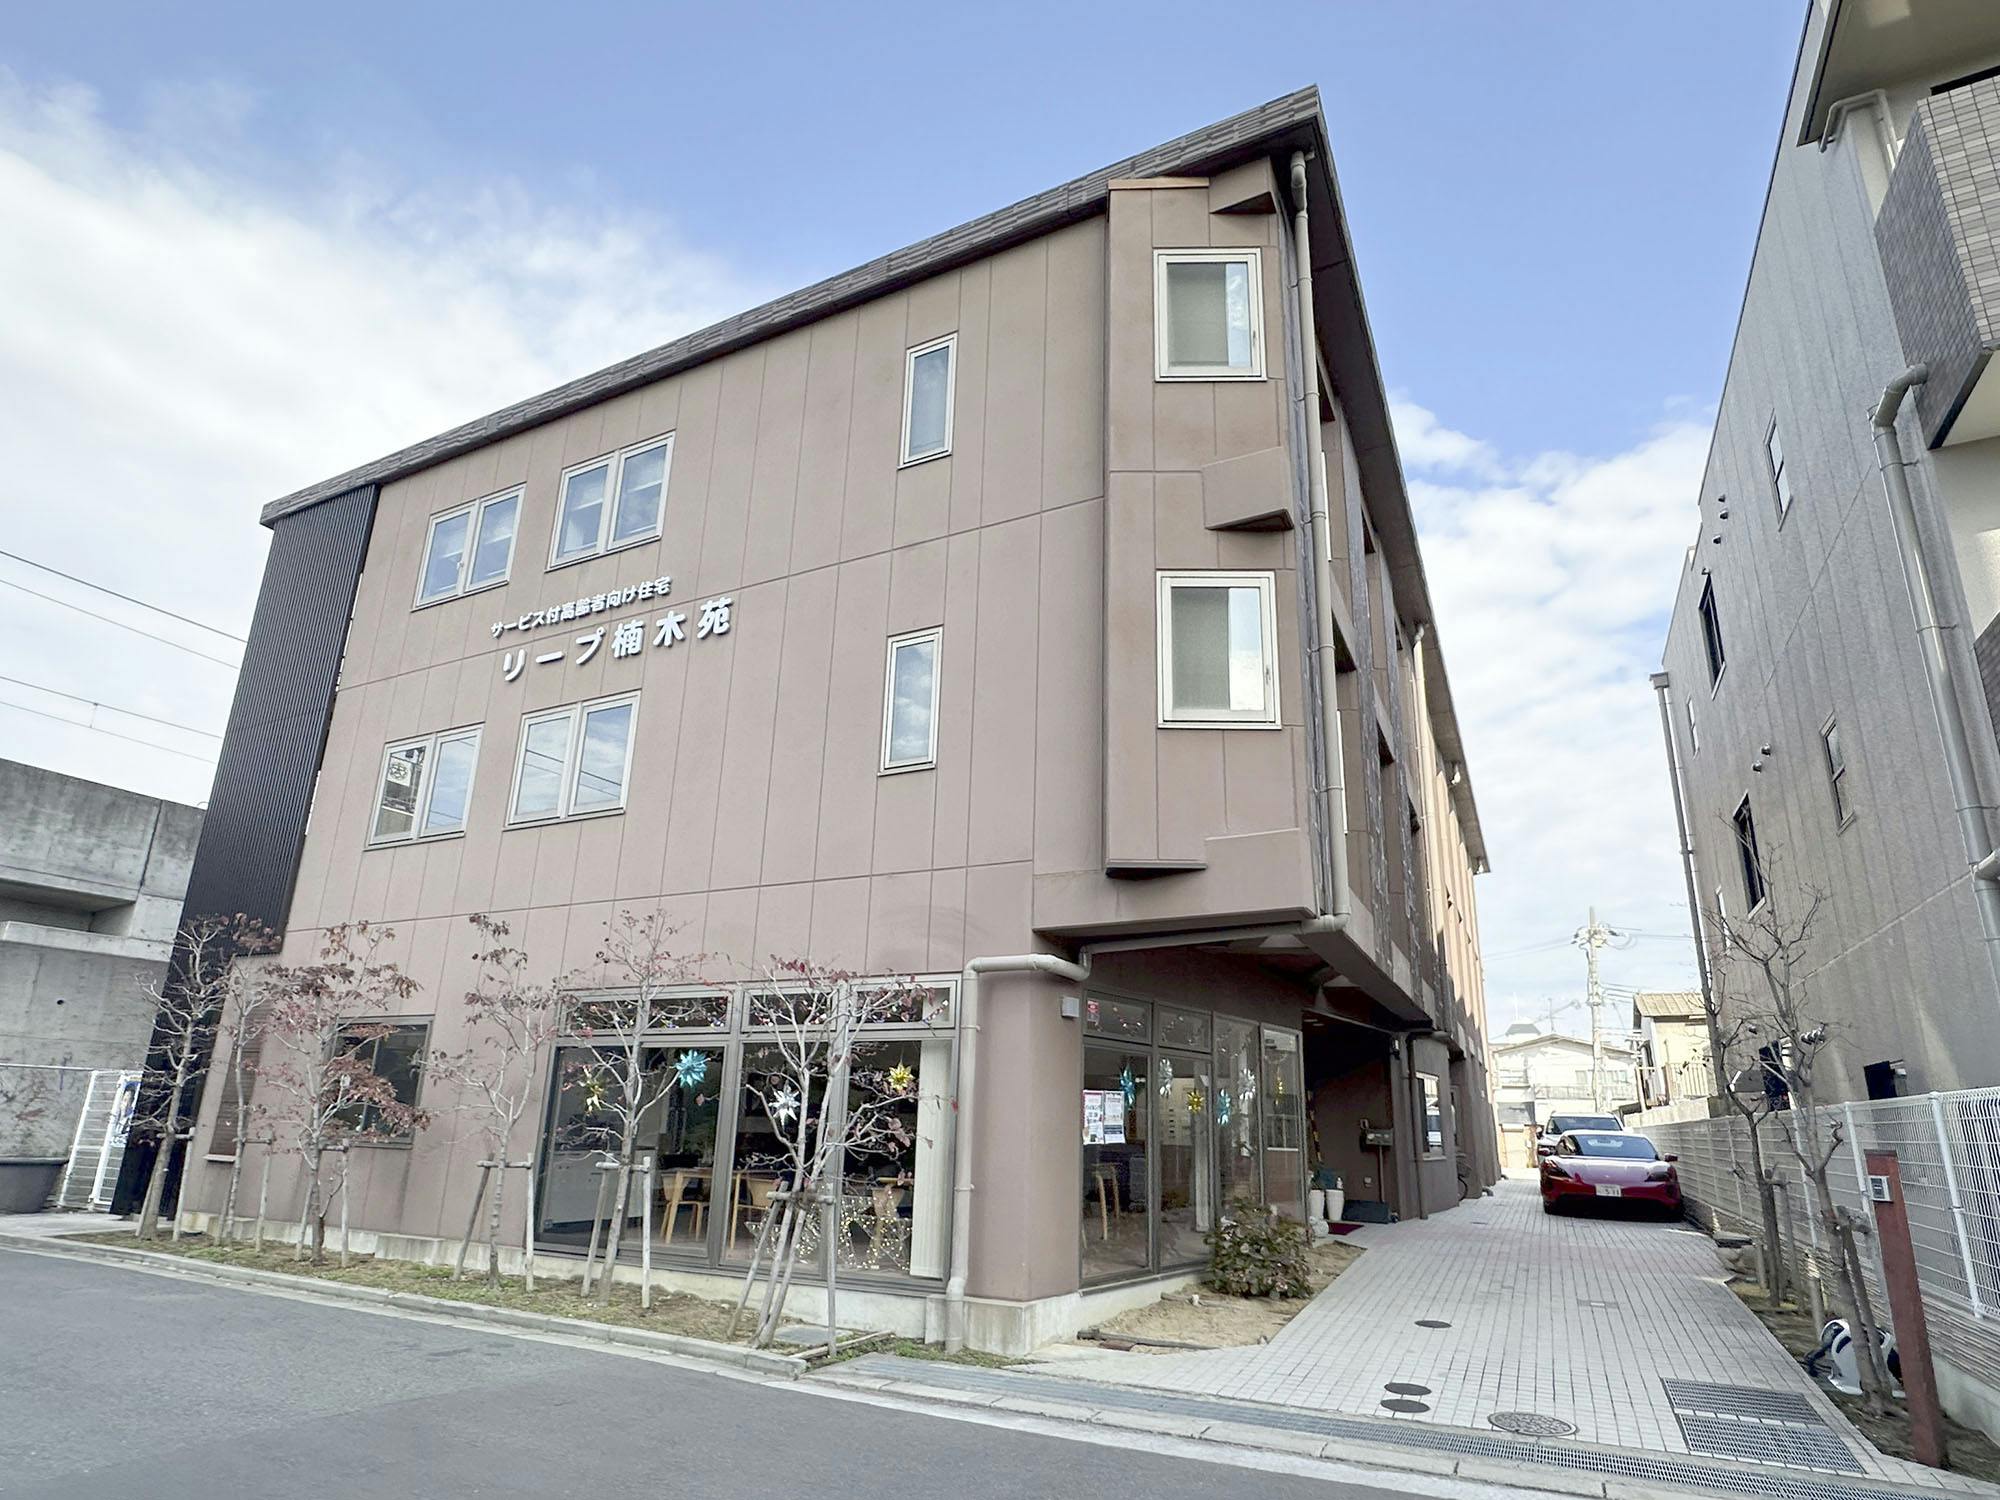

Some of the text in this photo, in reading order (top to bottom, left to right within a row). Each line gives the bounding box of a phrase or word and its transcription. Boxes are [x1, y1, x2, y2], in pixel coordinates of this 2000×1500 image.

[491, 576, 671, 637] サービス付高齢者向け住宅
[503, 597, 732, 681] リープ楠木苑
